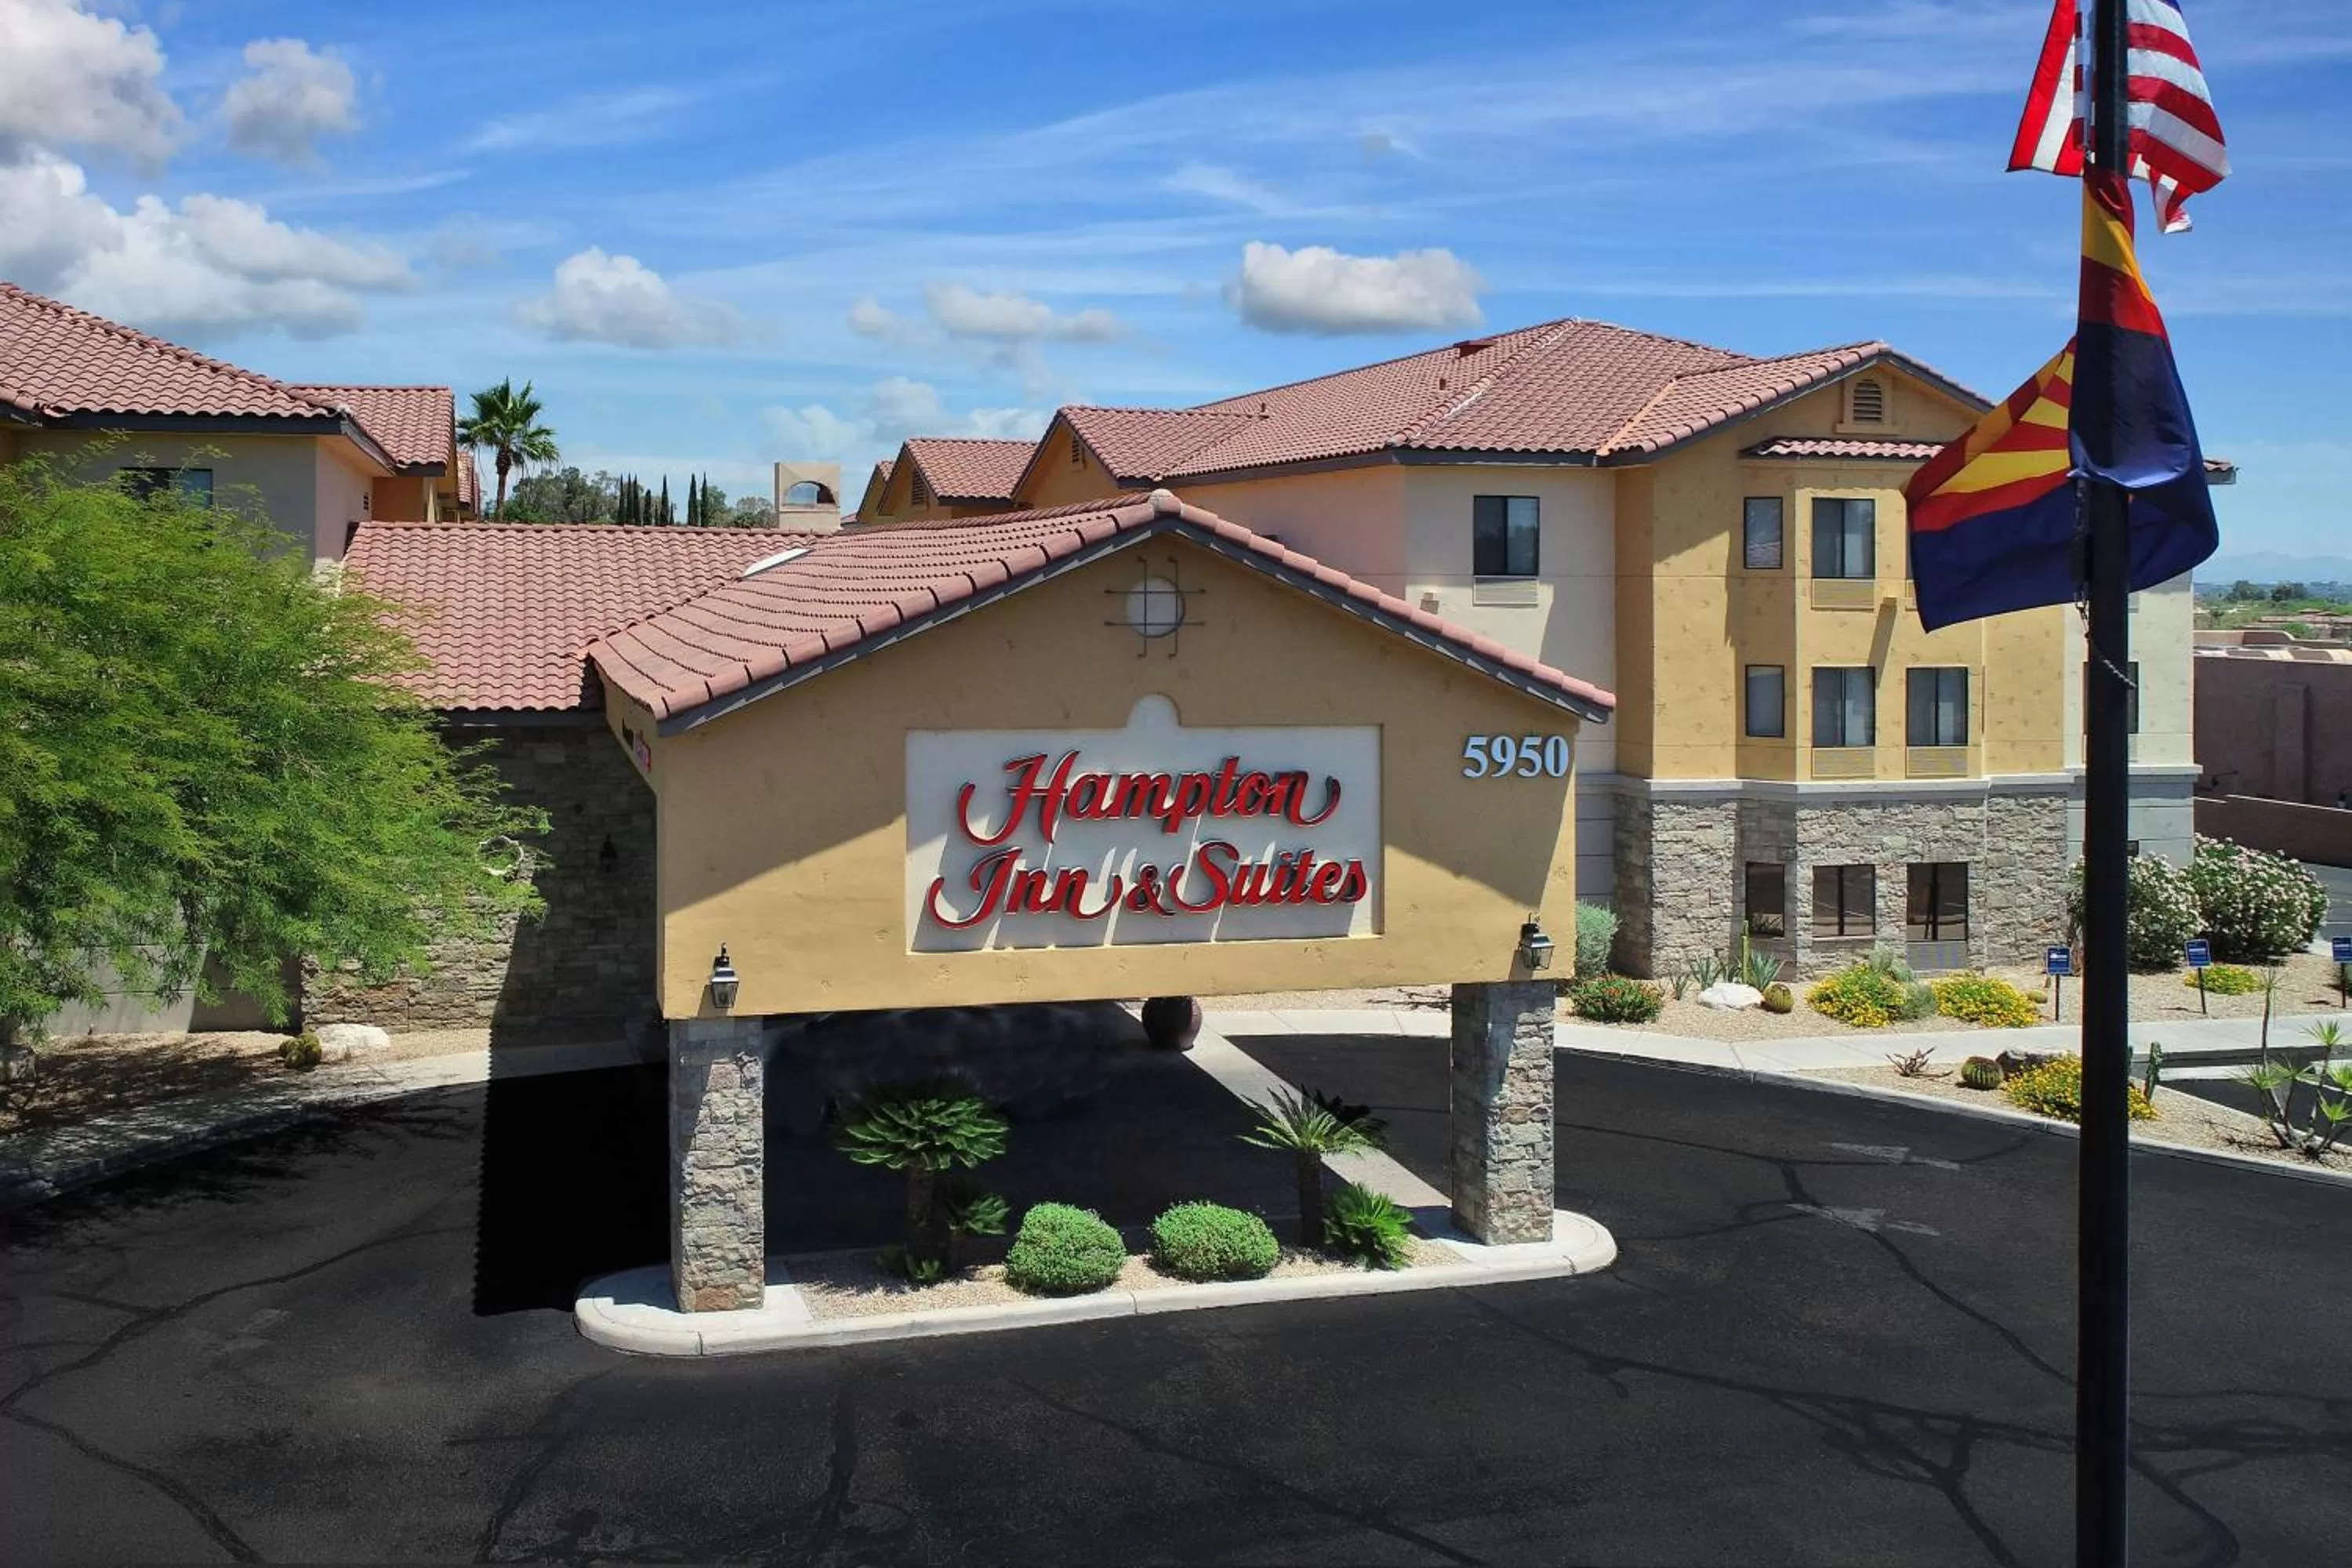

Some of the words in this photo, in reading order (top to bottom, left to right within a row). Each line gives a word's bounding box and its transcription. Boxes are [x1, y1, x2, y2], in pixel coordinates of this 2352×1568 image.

[957, 749, 1341, 847] Hampton
[1461, 735, 1570, 779] 5950
[927, 846, 1123, 930] Inn
[1126, 862, 1177, 920] &
[1167, 839, 1367, 914] Suites
